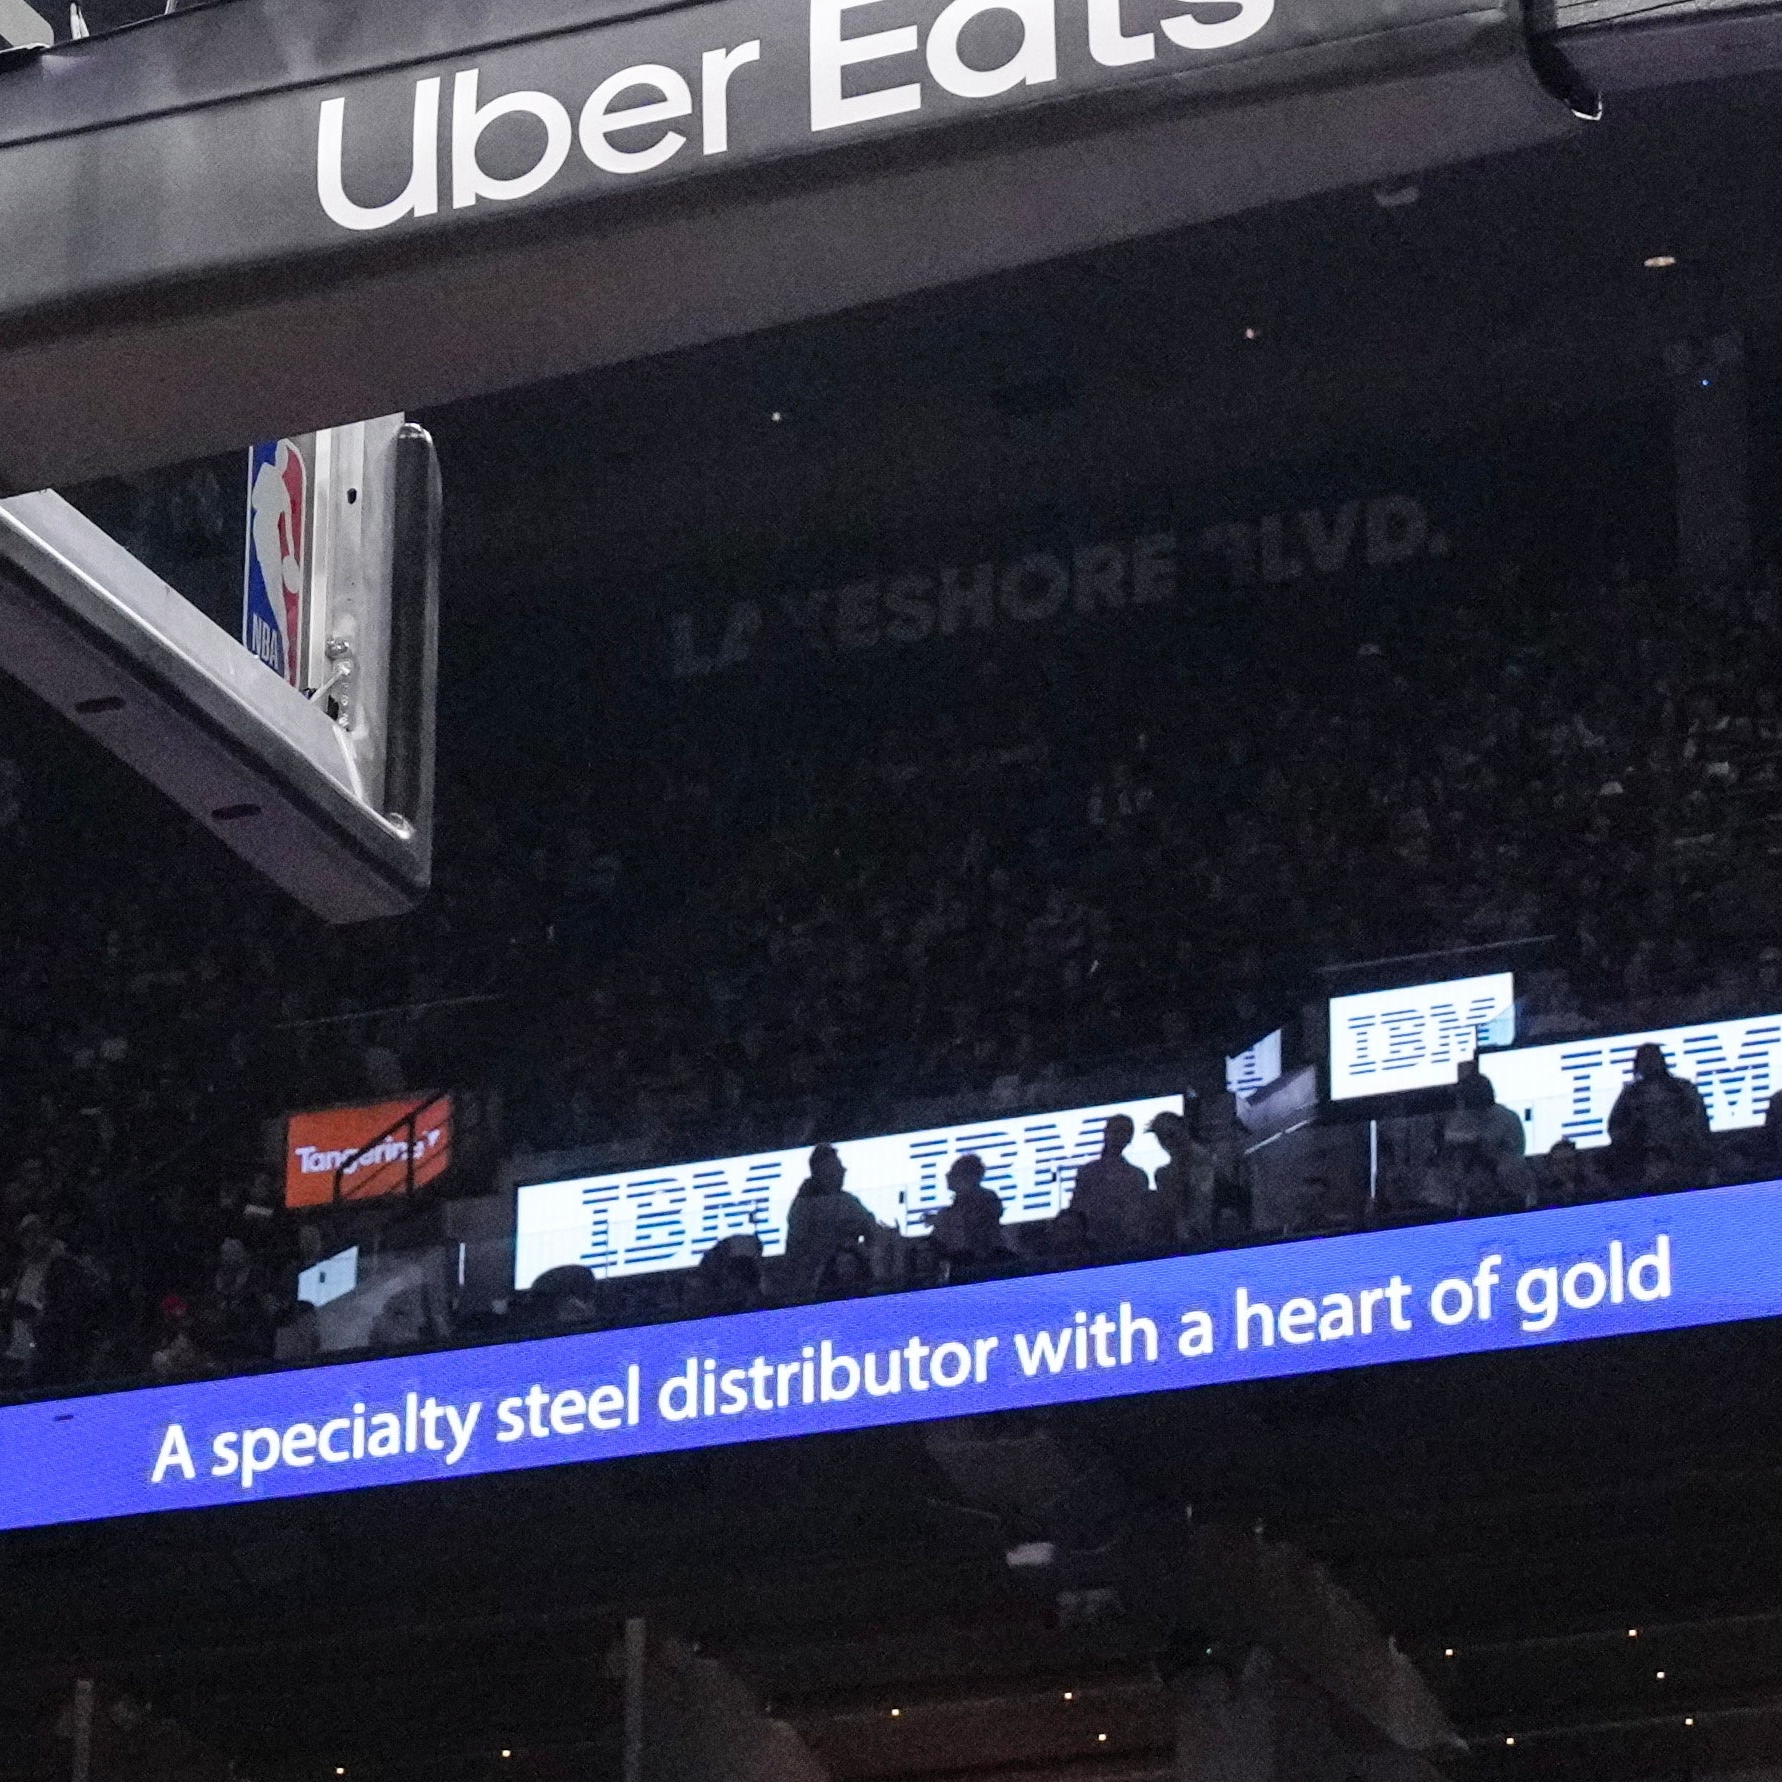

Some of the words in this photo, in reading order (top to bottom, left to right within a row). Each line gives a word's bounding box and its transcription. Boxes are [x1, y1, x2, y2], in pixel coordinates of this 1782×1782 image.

[316, 38, 759, 230] Uber
[809, 0, 1274, 132] Eats
[251, 612, 279, 669] NBA
[670, 534, 1177, 678] LAESHORE
[1202, 494, 1452, 584] LVD.
[1348, 997, 1496, 1076] IBM
[579, 1161, 782, 1271] IBM
[152, 1424, 195, 1482] A
[211, 1395, 482, 1488] specialty
[495, 1364, 639, 1443] steel
[657, 1336, 998, 1423] distributor
[1013, 1301, 1158, 1376] with
[1177, 1310, 1215, 1358] a
[1234, 1275, 1413, 1352] heart
[1431, 1254, 1504, 1326] of
[1516, 1234, 1673, 1333] gold
